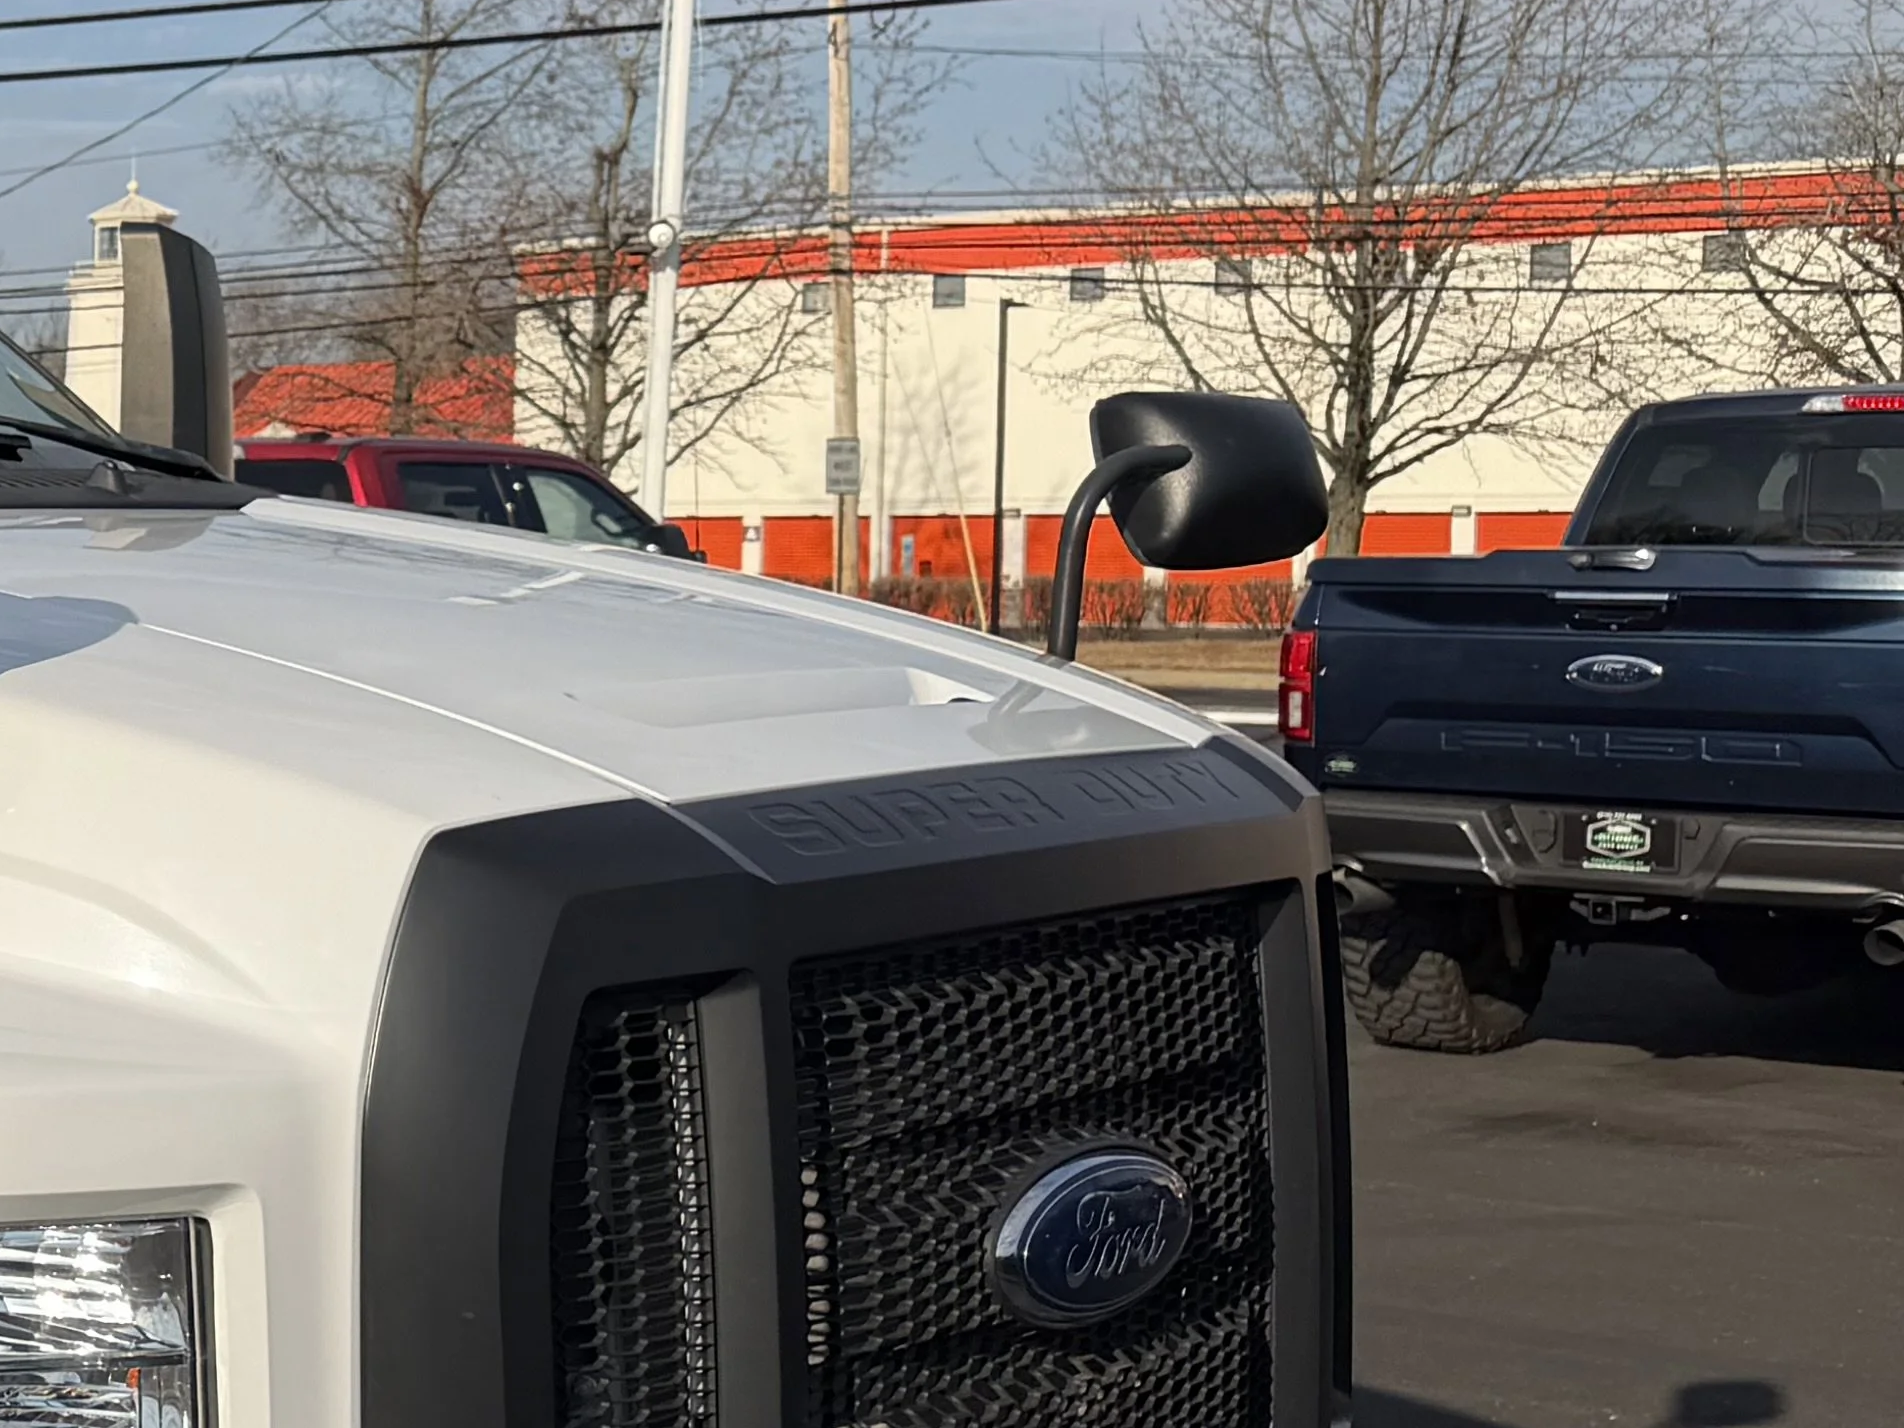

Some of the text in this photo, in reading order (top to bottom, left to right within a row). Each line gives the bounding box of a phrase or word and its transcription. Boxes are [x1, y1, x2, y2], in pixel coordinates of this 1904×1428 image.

[1438, 727, 1804, 768] F-150
[746, 758, 1241, 857] SUPER DUTY
[1065, 1185, 1167, 1289] Ford
